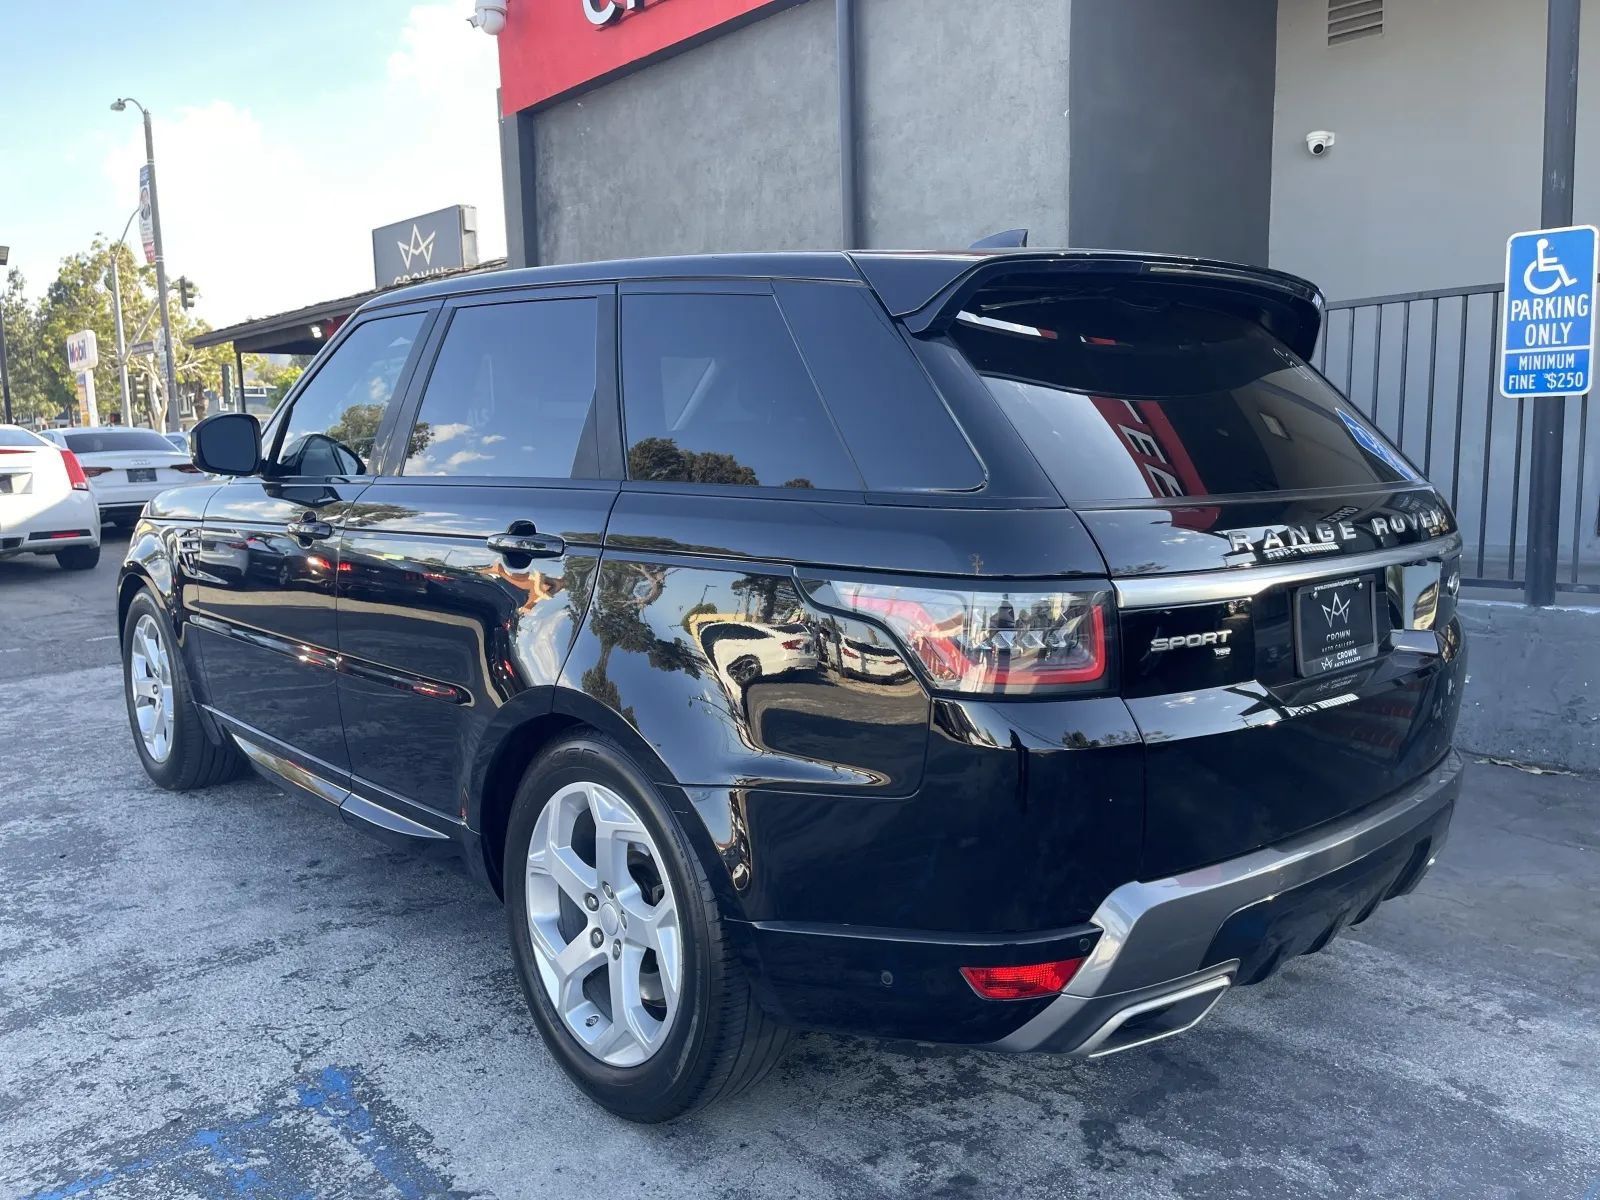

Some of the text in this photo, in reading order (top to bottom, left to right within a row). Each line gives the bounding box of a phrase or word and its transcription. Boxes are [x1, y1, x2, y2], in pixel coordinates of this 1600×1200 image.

[1510, 294, 1589, 322] PARKING
[1524, 321, 1573, 347] ONLY
[1518, 353, 1575, 371] MINIMUM
[1508, 371, 1584, 390] FINE $250
[1227, 520, 1357, 552] RANGE
[1150, 629, 1233, 652] SPORT
[1326, 630, 1351, 643] CROWN
[1337, 648, 1357, 660] CROWN
